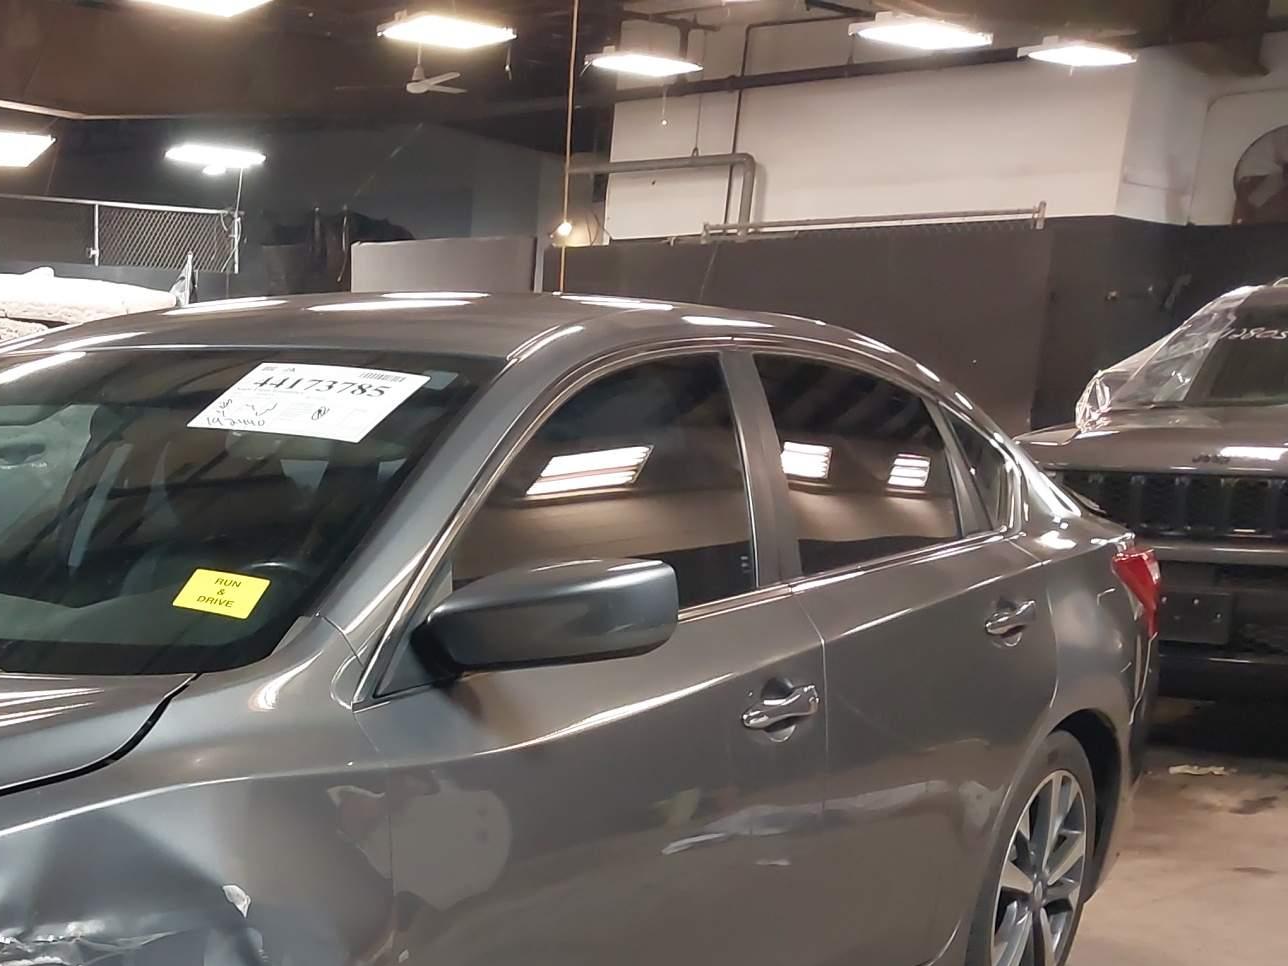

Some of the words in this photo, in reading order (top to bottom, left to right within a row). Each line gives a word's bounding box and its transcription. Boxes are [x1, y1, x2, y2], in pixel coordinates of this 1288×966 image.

[253, 376, 392, 397] 44173785
[214, 577, 242, 587] RUN
[196, 595, 234, 607] DRIVE
